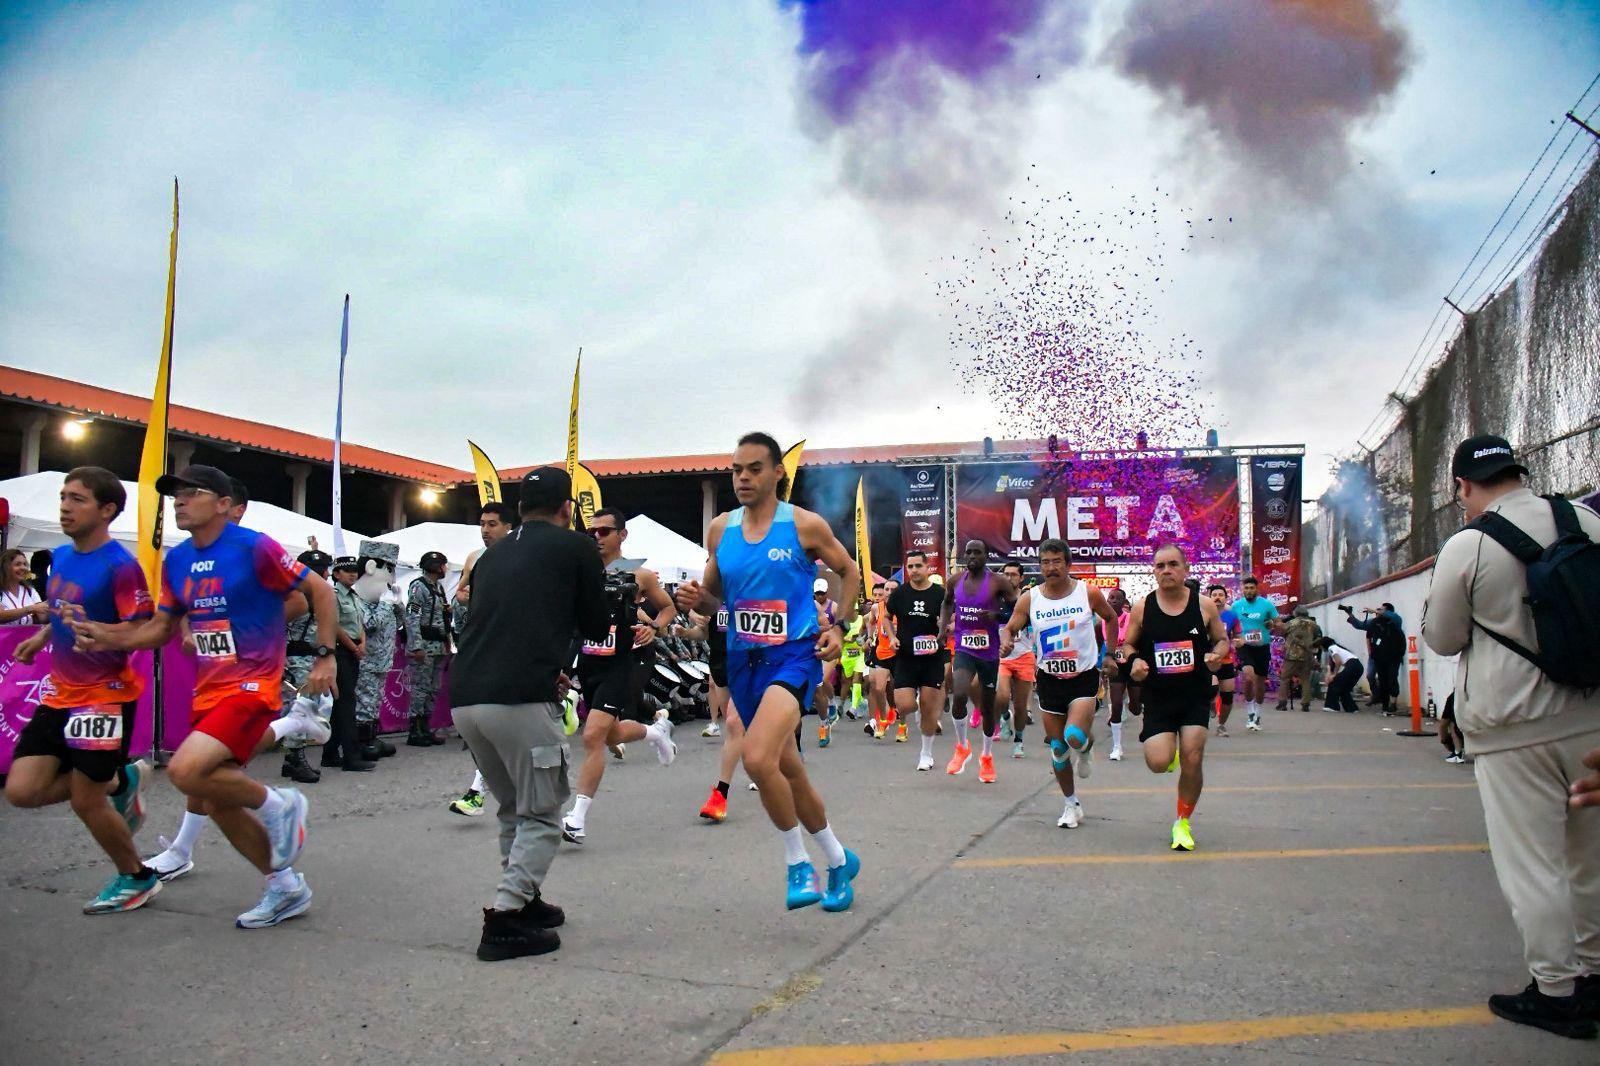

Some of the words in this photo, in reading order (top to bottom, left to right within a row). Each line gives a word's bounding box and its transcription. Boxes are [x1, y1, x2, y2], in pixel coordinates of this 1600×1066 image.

[1010, 495, 1186, 541] META
[768, 548, 792, 561] ON
[1071, 546, 1153, 556] POWERADE
[1036, 606, 1083, 619] Evolution
[739, 612, 784, 635] 0279
[196, 633, 230, 655] 0144
[915, 640, 937, 650] 0031
[963, 635, 987, 647] 1206
[1157, 650, 1191, 666] 1238
[1045, 659, 1077, 673] 1308
[70, 717, 117, 738] 0187
